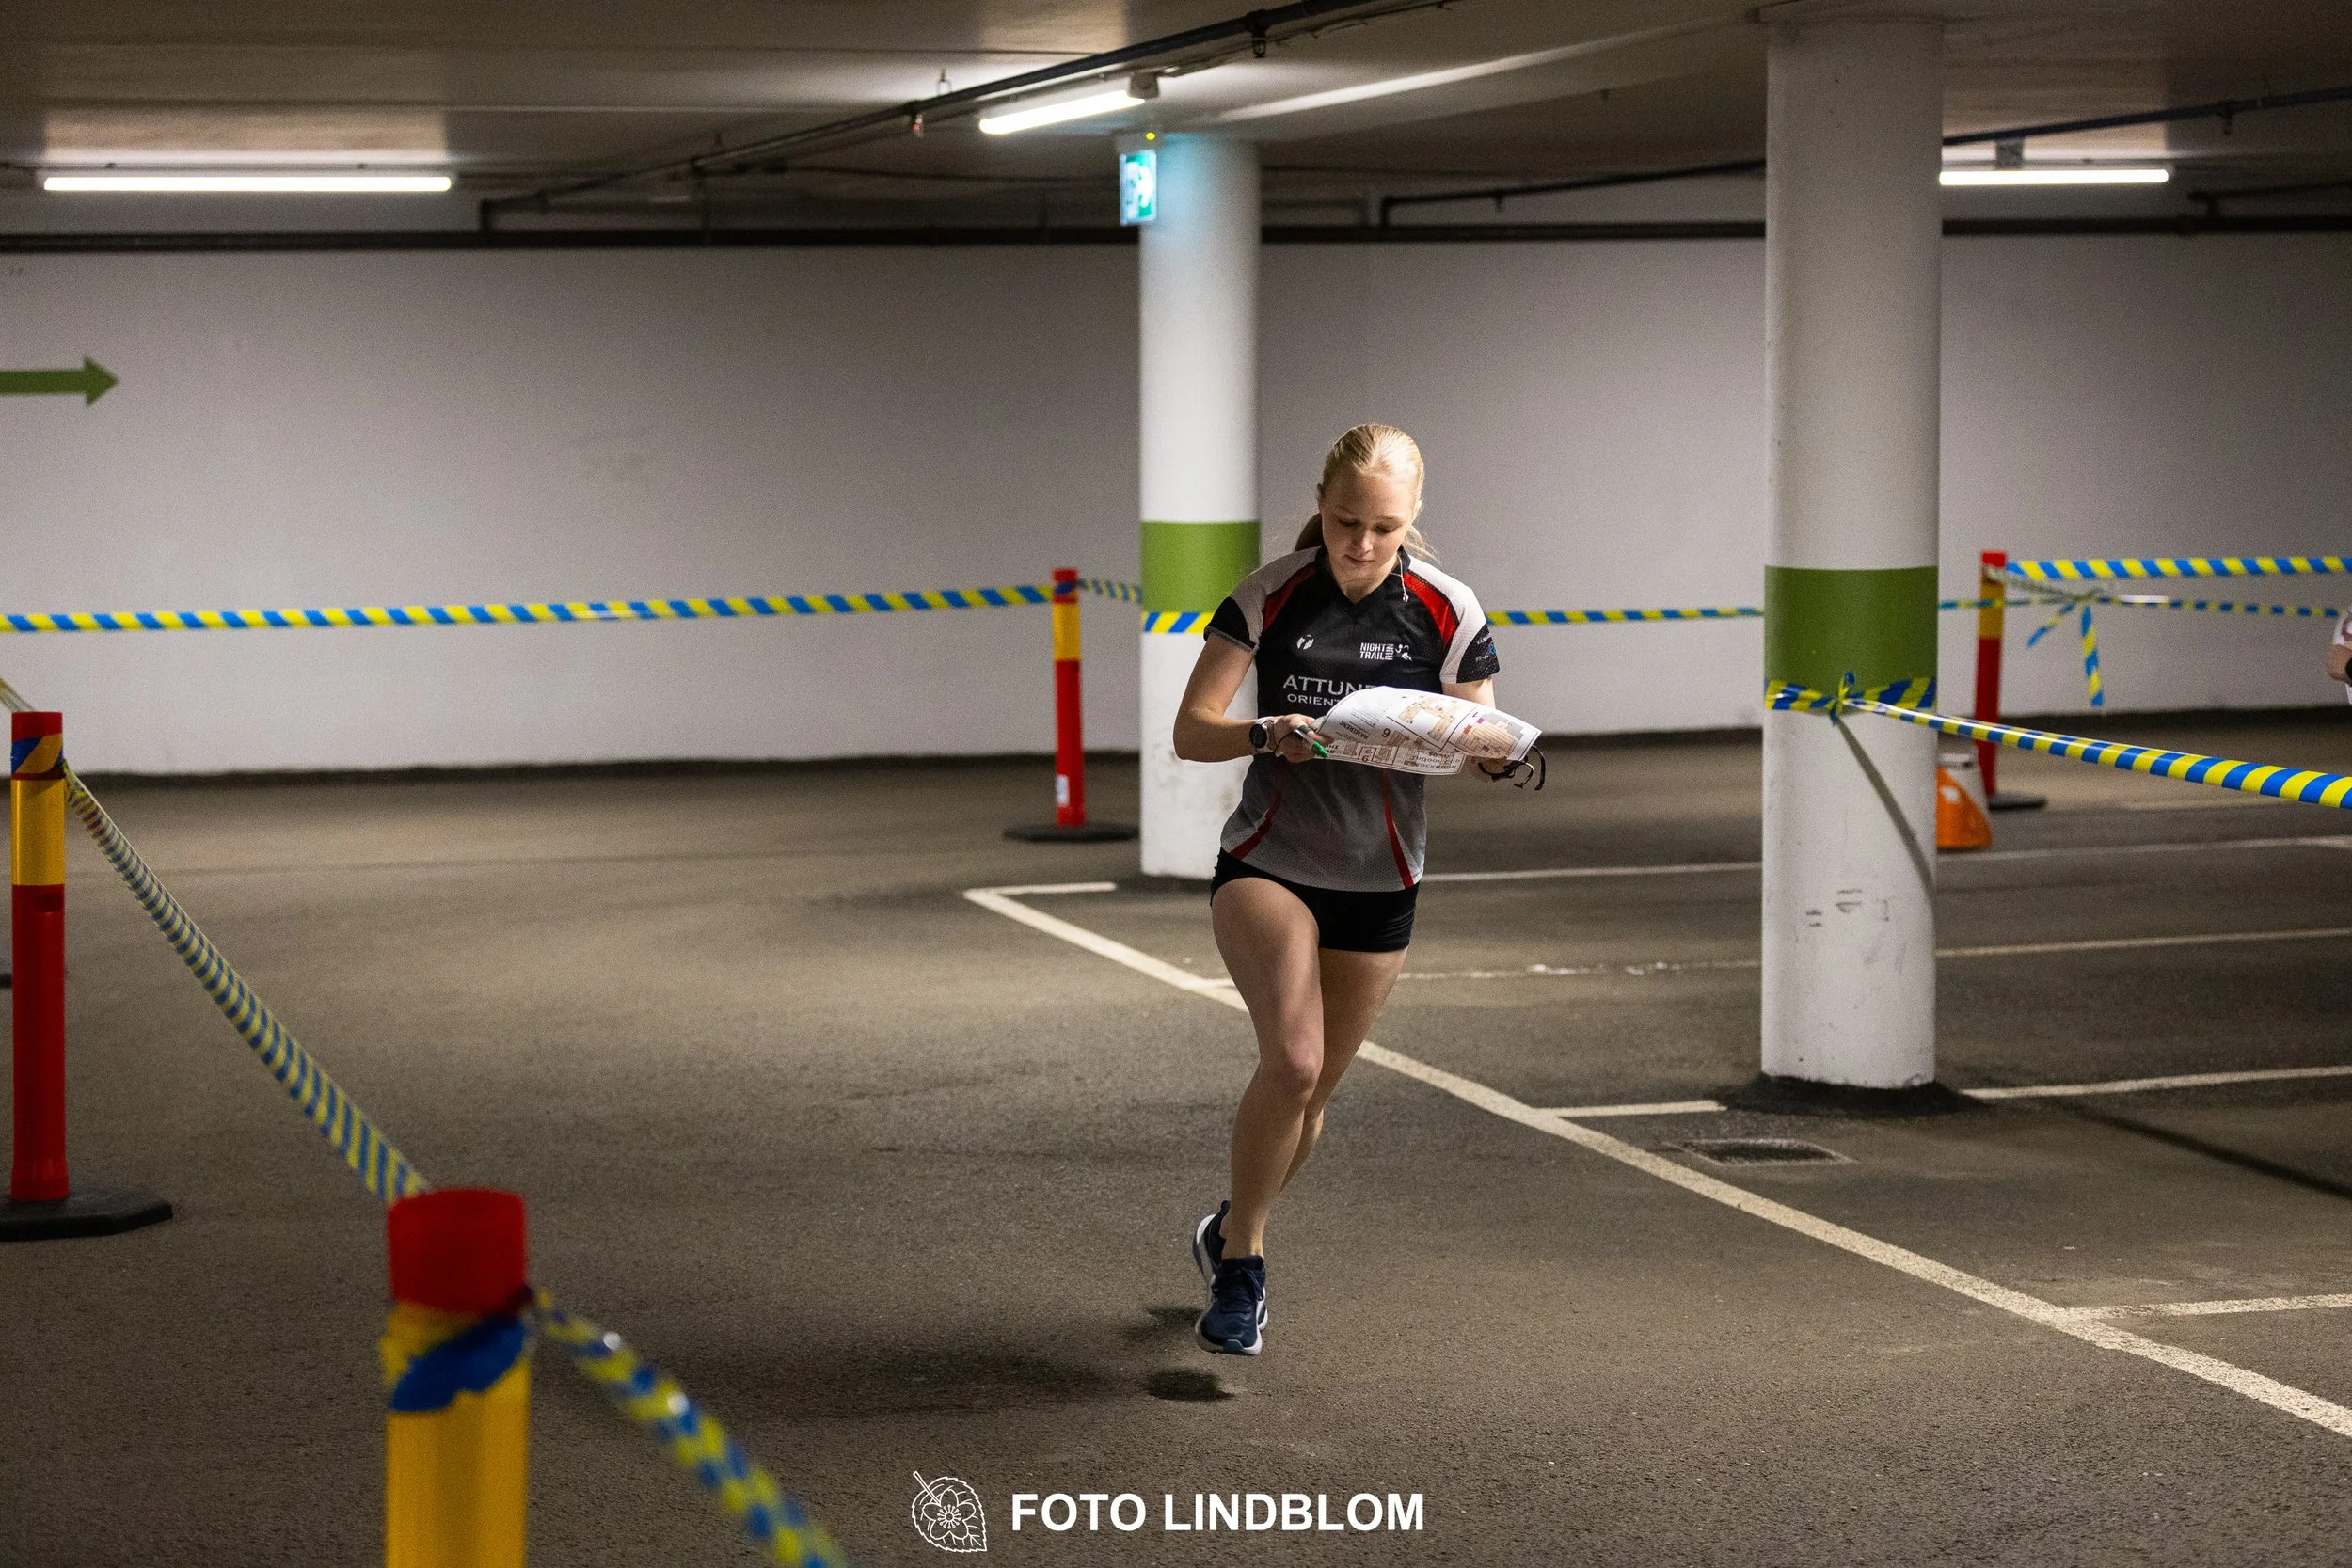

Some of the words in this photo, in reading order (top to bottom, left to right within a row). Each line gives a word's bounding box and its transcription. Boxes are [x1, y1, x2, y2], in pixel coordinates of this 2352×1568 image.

[1360, 642, 1386, 652] NIGHT
[1385, 643, 1394, 660] RUN
[1359, 651, 1385, 660] TRAIL
